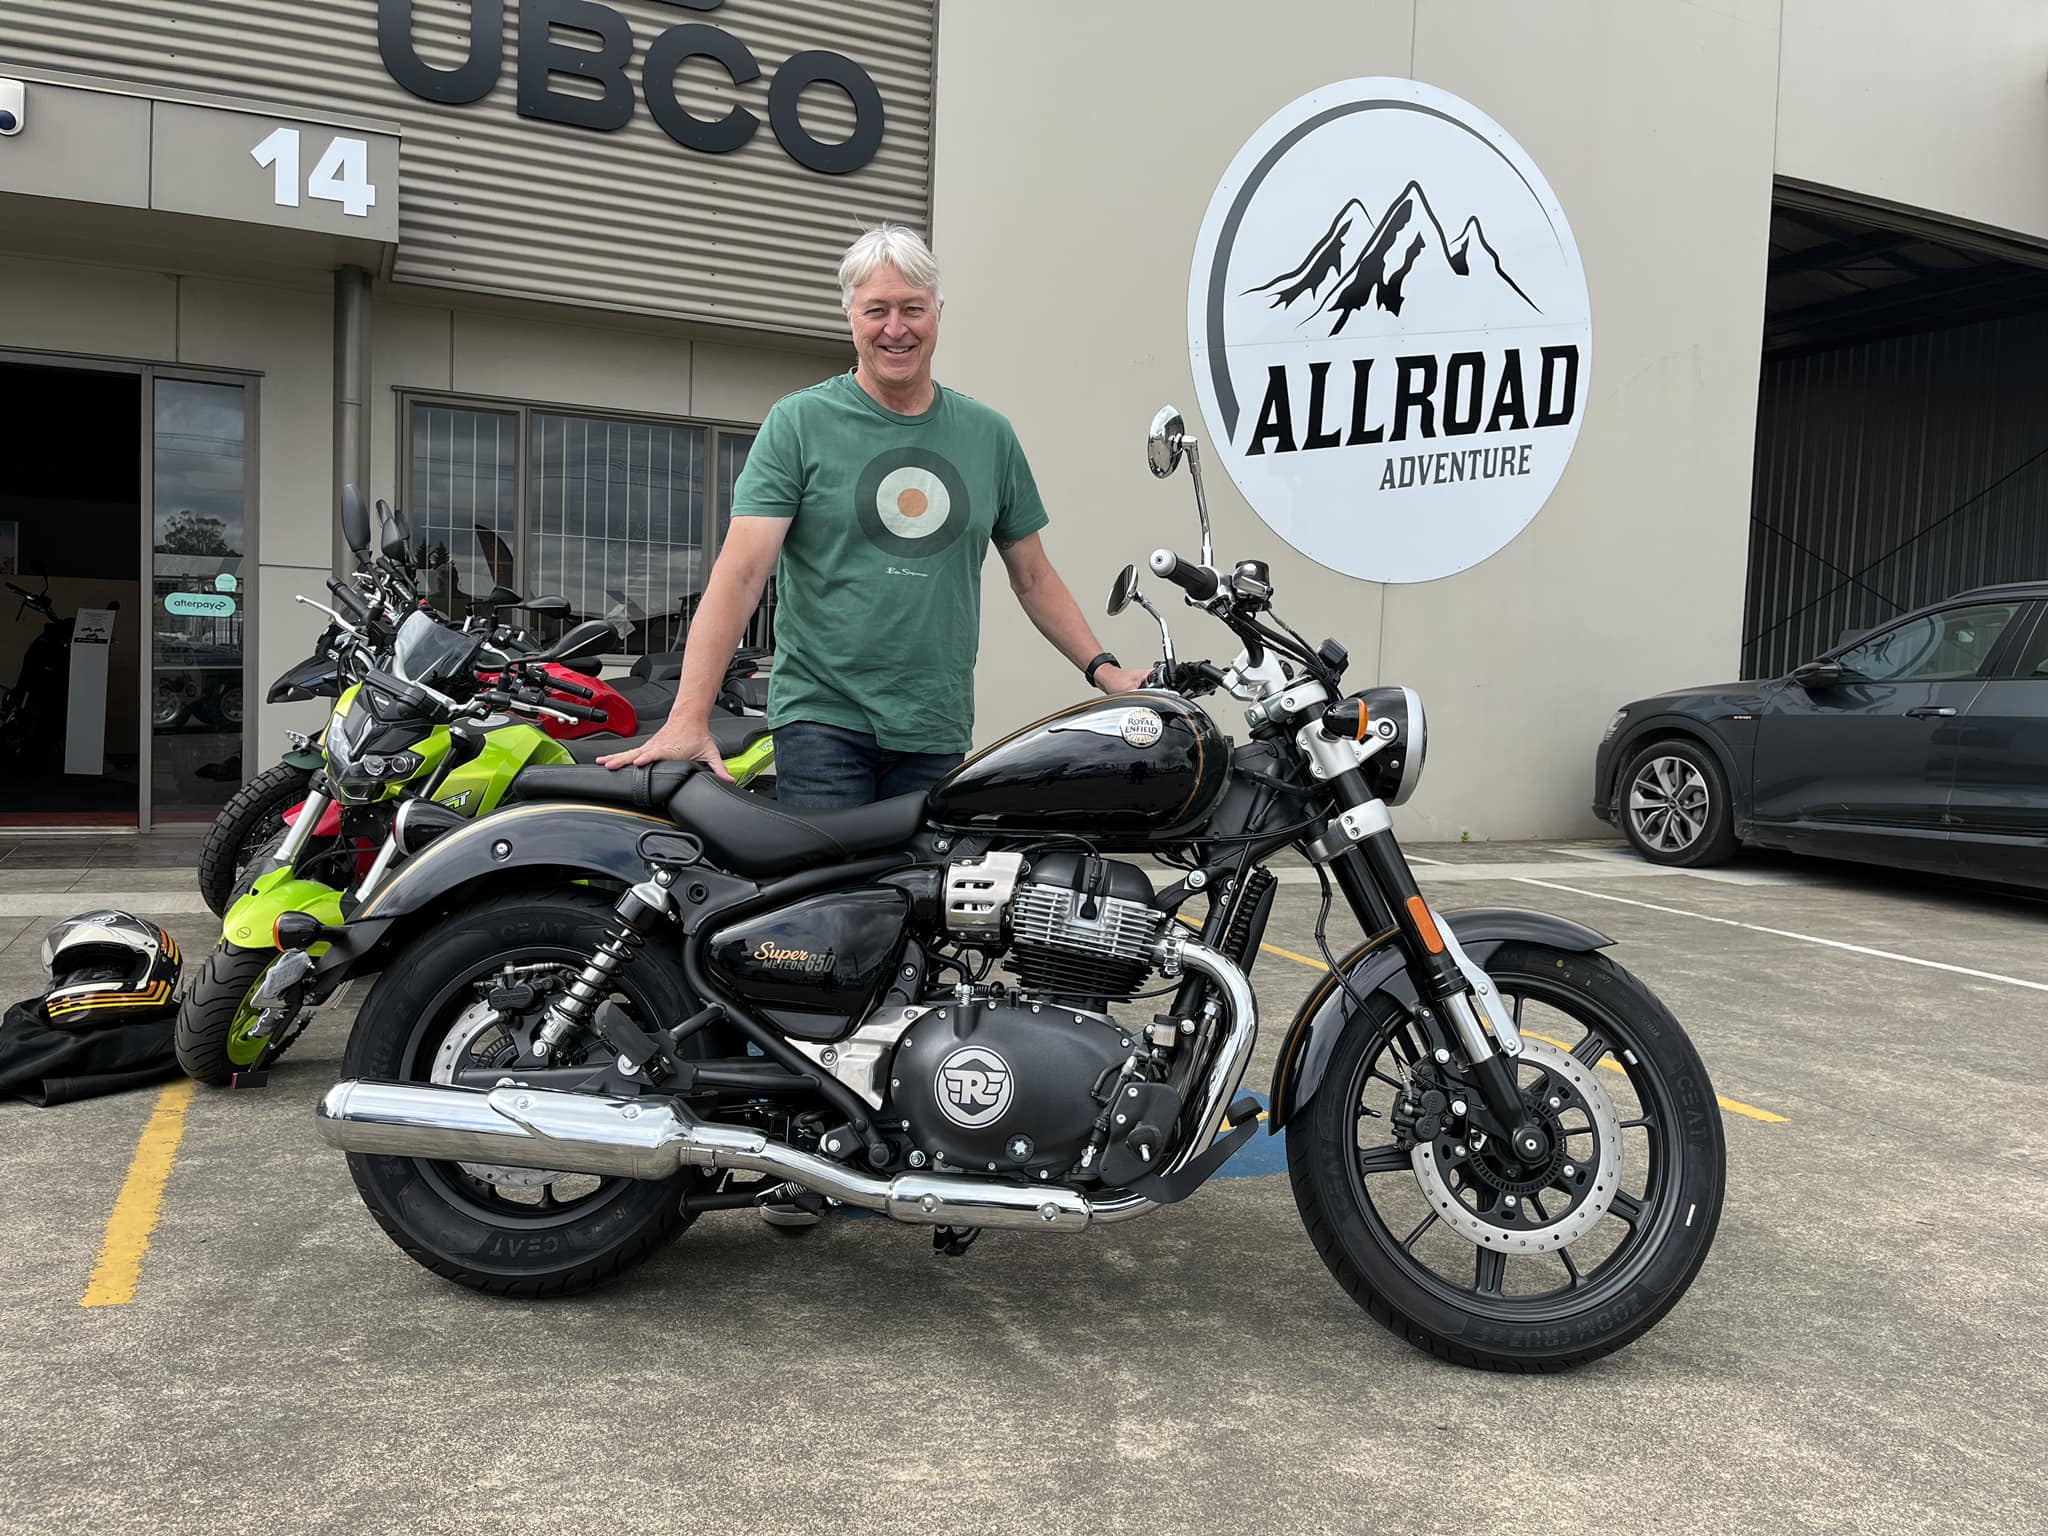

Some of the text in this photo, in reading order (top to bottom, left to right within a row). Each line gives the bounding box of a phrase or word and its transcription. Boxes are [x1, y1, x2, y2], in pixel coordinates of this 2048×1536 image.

[378, 0, 884, 174] UBCO
[249, 127, 376, 217] 14
[1244, 344, 1580, 456] ALLROAD
[1378, 444, 1533, 491] ADVENTURE
[174, 599, 216, 610] afterpay
[1125, 726, 1158, 735] ENFIELD
[1127, 718, 1155, 726] ROYAL
[753, 941, 809, 964] Super
[762, 953, 837, 973] METEOR 650
[489, 1236, 560, 1258] CEAT
